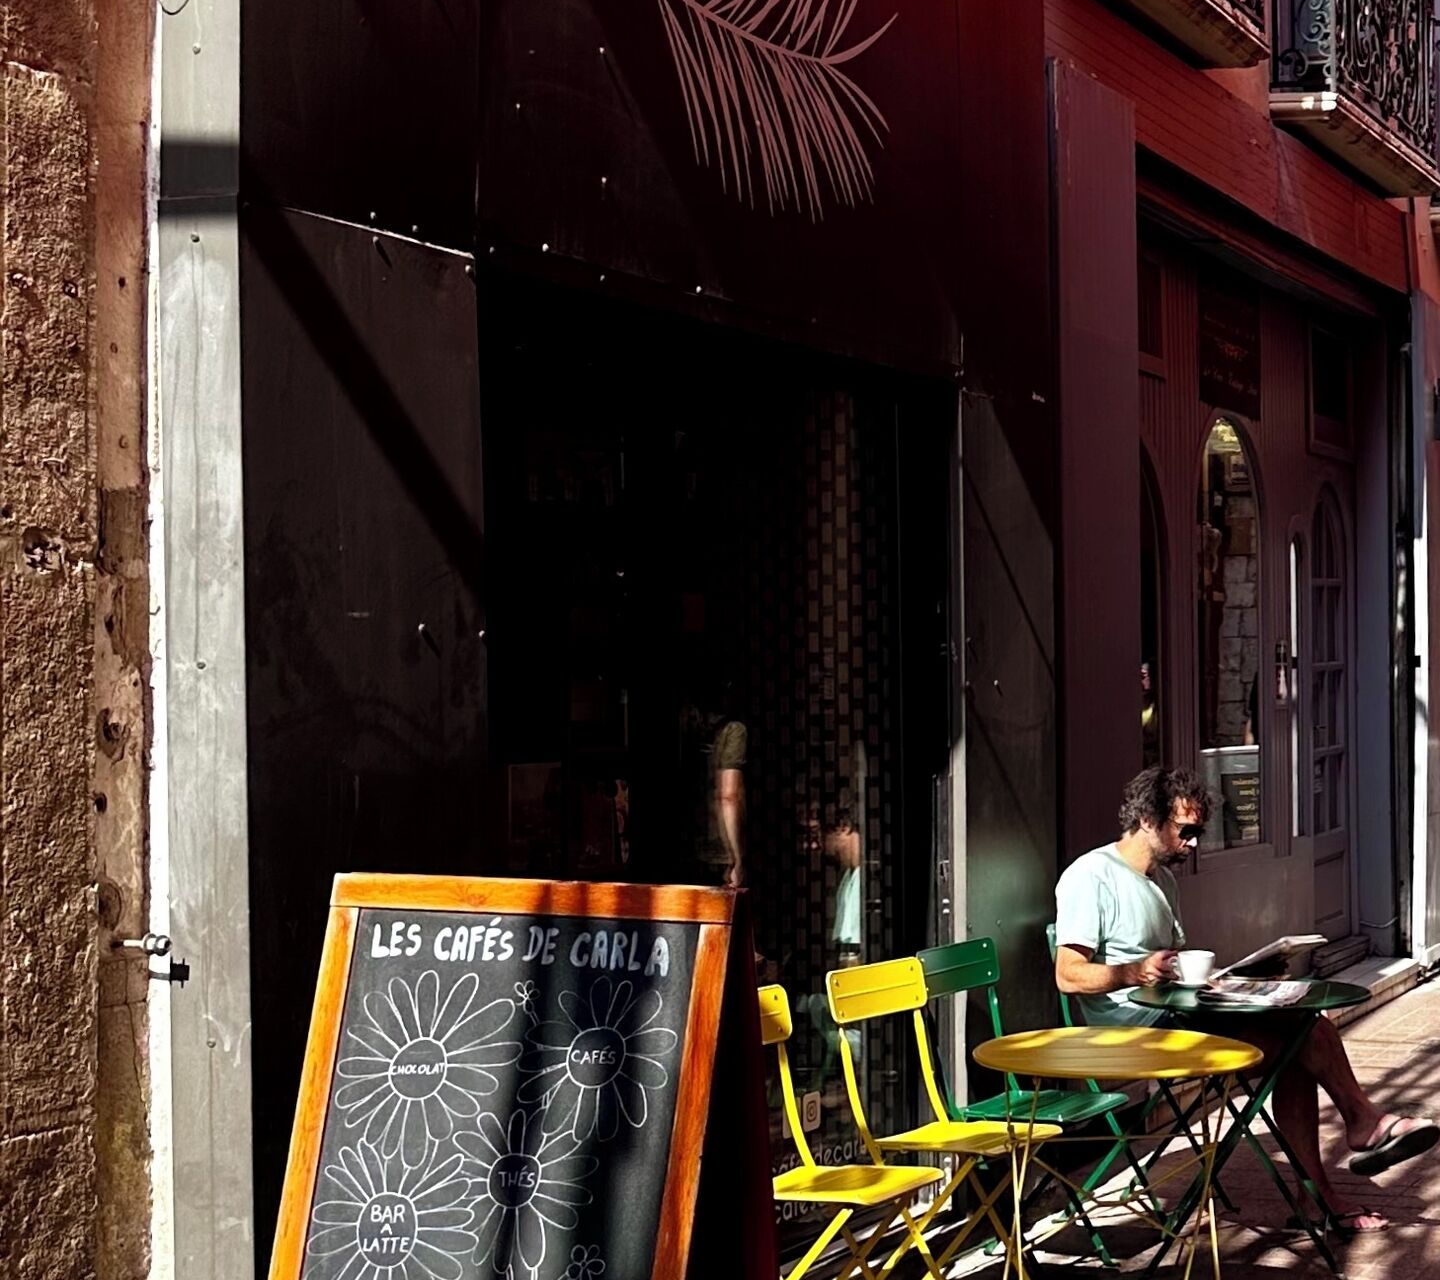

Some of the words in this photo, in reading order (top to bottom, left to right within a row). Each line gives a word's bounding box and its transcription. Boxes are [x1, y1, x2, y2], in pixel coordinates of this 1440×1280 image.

[370, 921, 422, 959] LES
[433, 916, 514, 962] CAFÉS
[521, 925, 560, 965] DE
[569, 930, 670, 977] CARLA
[570, 1045, 617, 1065] CAFÉS
[389, 1062, 445, 1076] CHOCOLAT
[497, 1165, 536, 1189] THÉS
[370, 1204, 406, 1224] BAR
[380, 1223, 393, 1235] A
[362, 1237, 411, 1254] LATTE
